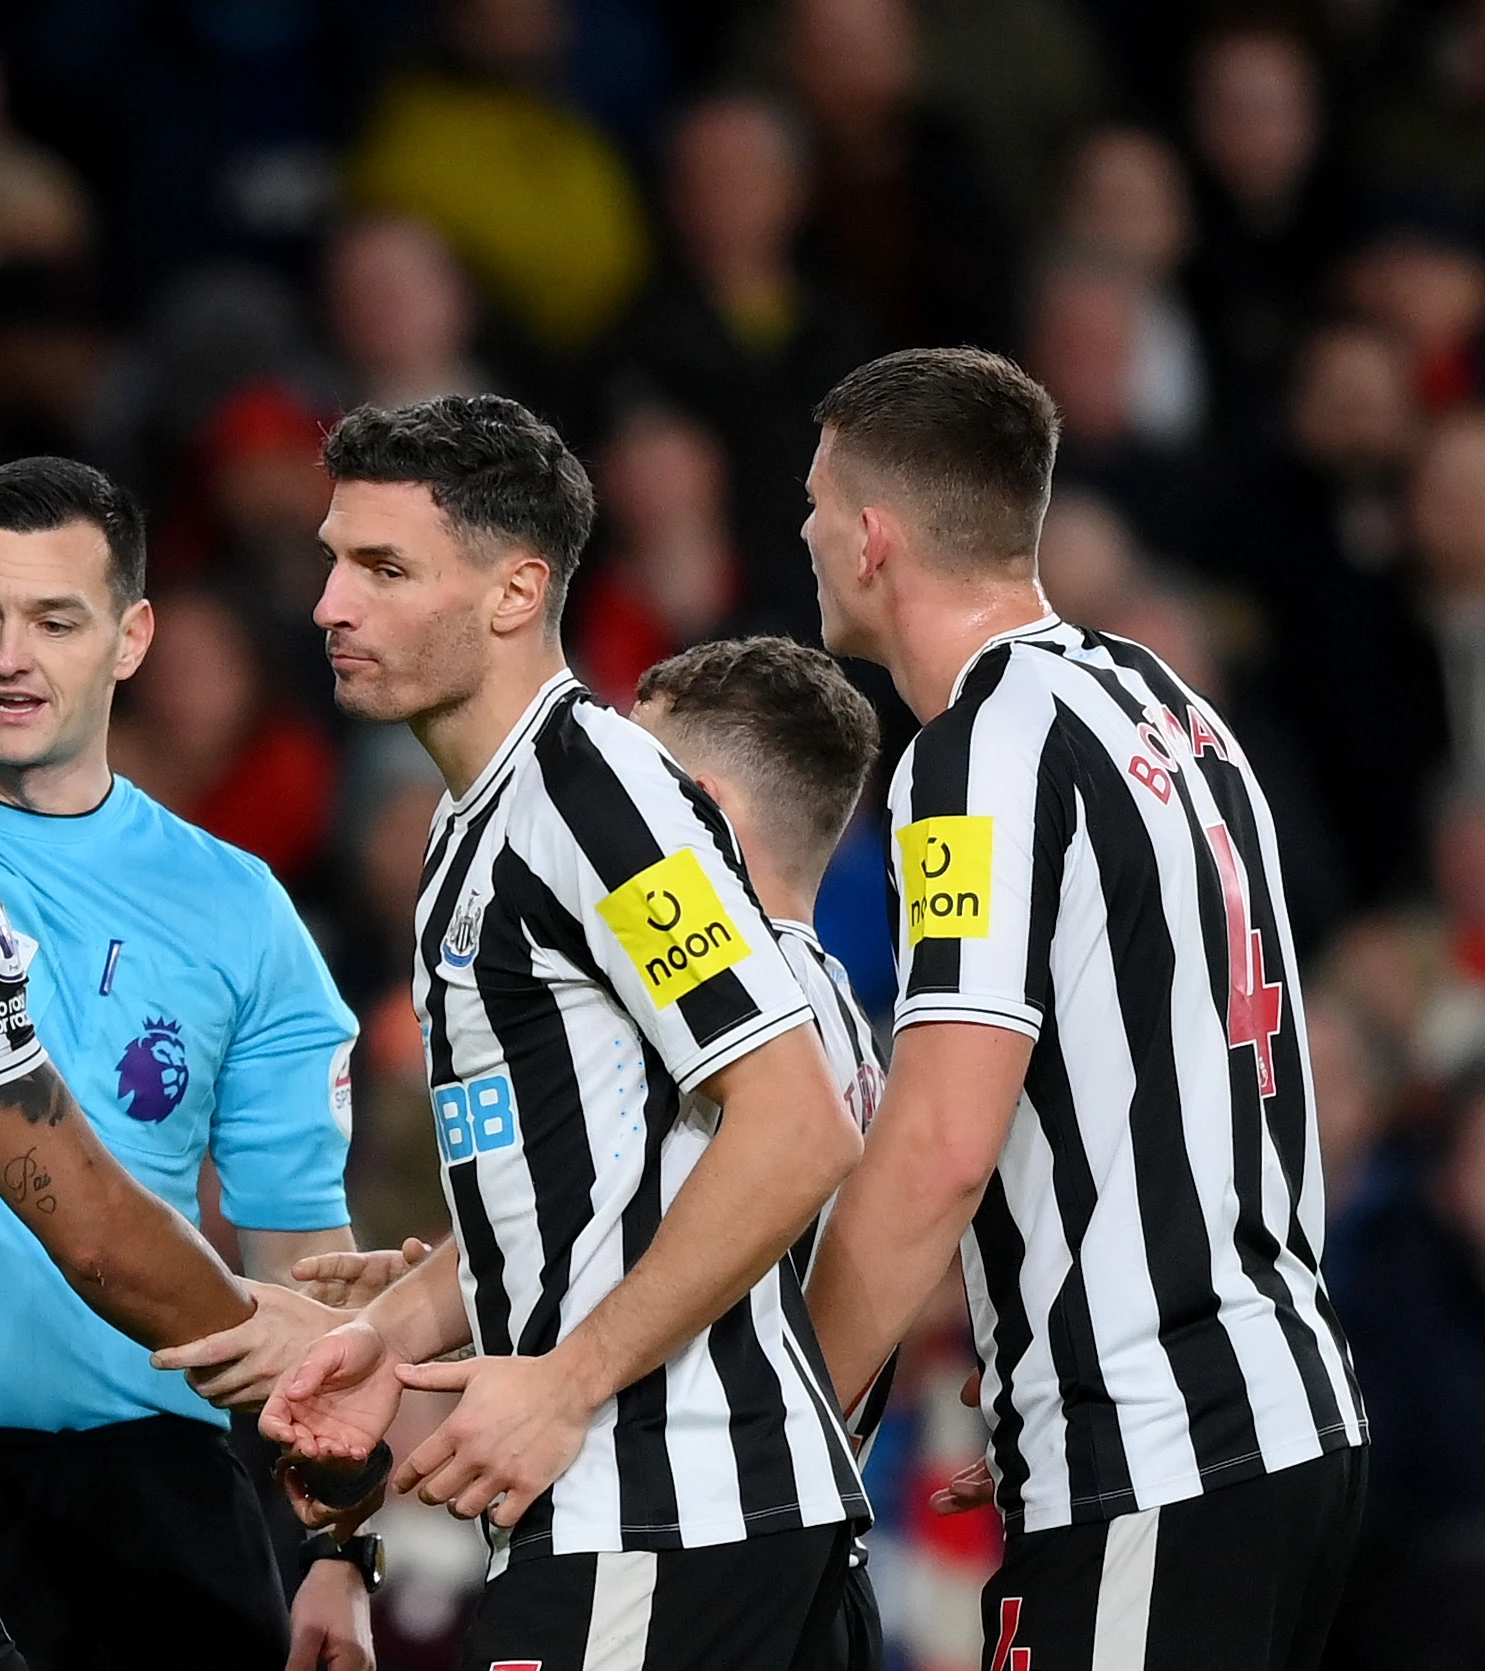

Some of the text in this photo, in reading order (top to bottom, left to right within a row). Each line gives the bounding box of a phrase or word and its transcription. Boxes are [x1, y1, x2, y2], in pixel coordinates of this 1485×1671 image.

[911, 892, 980, 928] noon
[645, 921, 733, 987] noon
[1205, 819, 1283, 1098] 4
